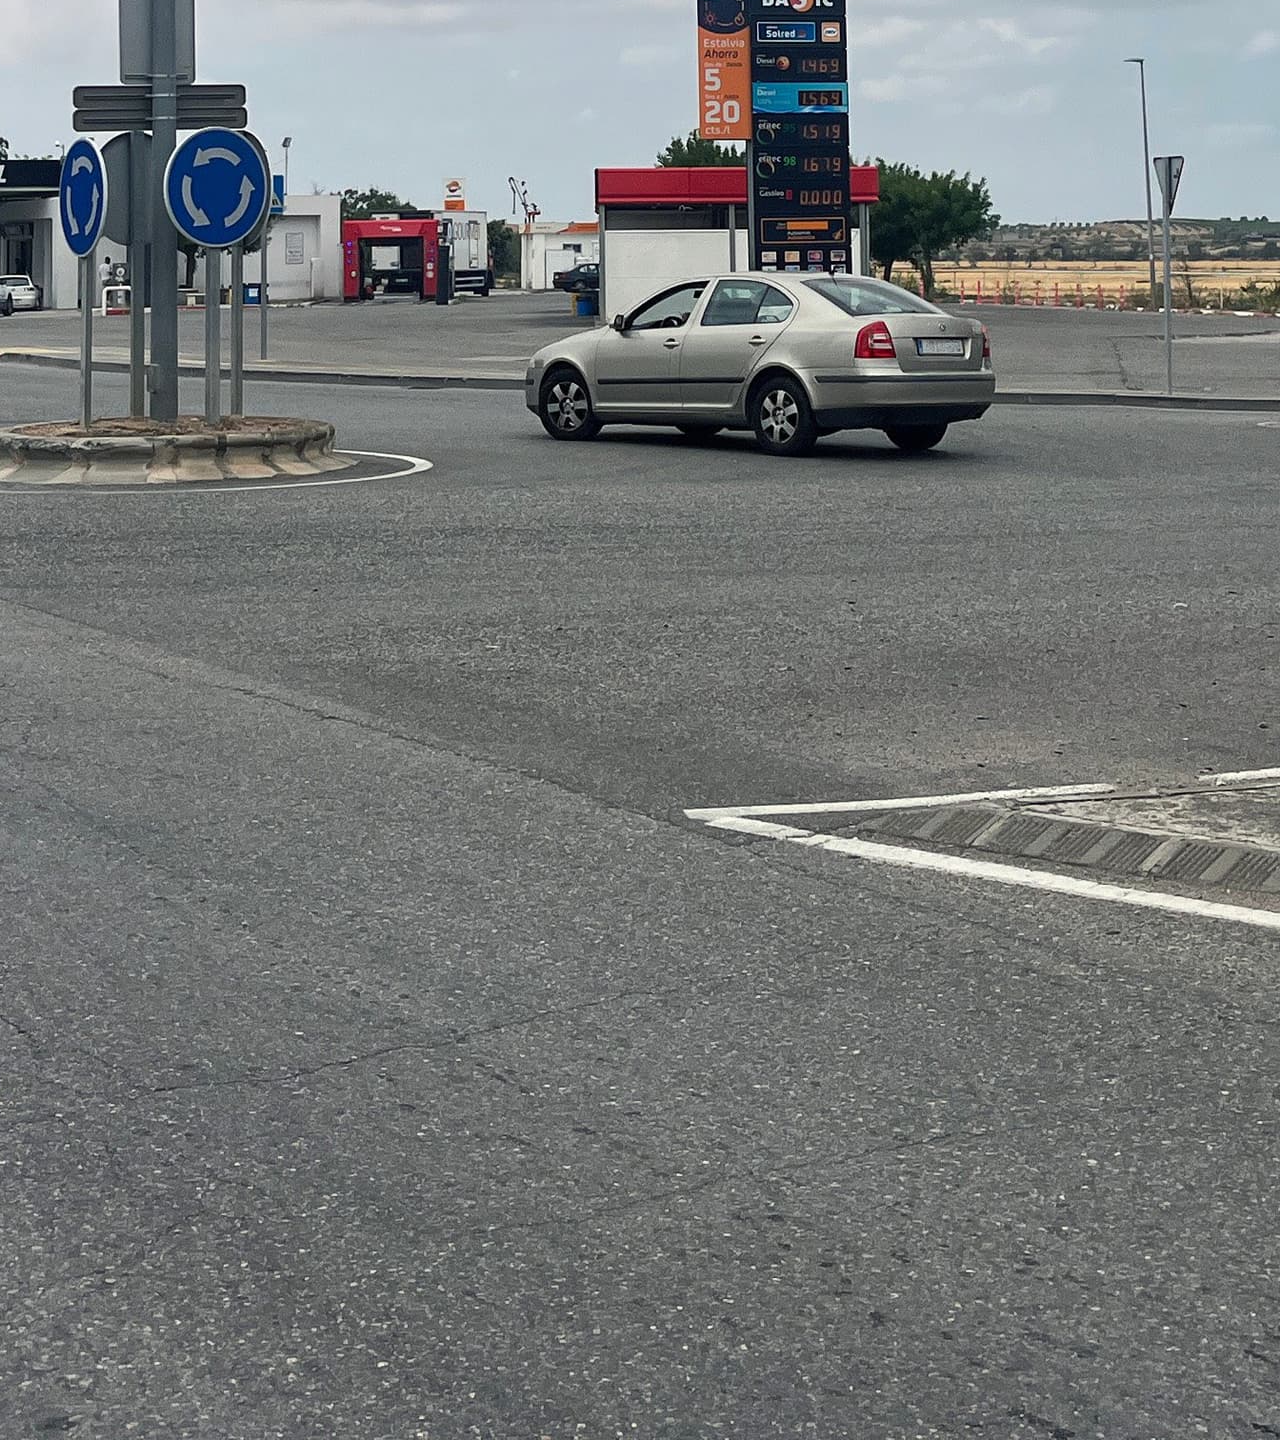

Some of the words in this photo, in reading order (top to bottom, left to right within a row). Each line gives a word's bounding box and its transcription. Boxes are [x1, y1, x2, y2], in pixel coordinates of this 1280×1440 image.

[766, 29, 796, 38] Solred
[703, 38, 745, 48] Estalvia
[704, 48, 739, 59] Ahorra
[704, 68, 721, 91] 5
[705, 100, 740, 123] 20
[783, 156, 796, 166] 98
